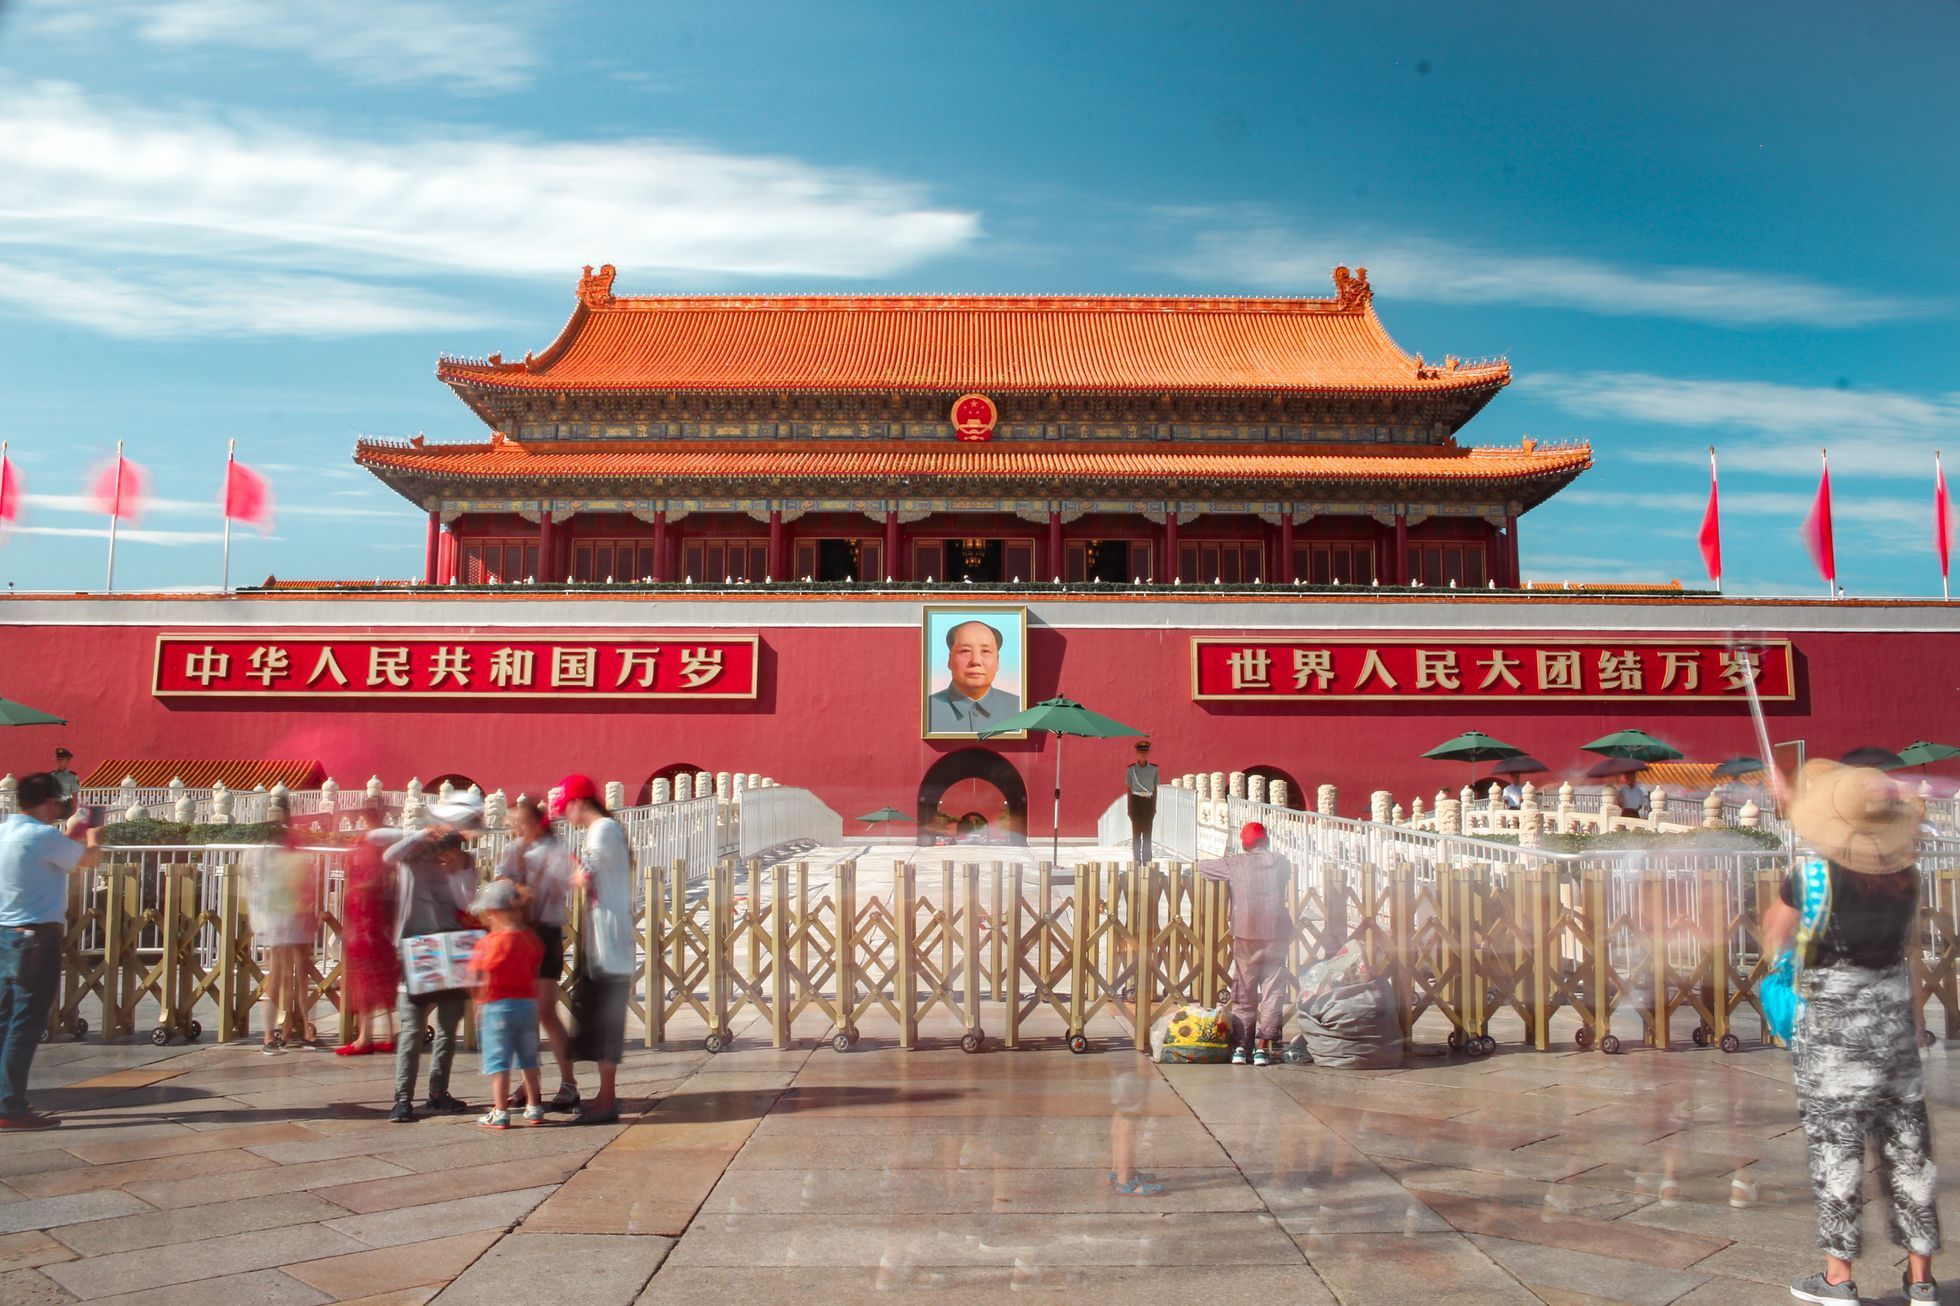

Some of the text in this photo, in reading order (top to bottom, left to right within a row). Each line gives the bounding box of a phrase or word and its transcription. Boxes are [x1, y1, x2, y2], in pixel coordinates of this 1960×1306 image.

[184, 646, 723, 688] 中华人民共和国万岁
[1226, 649, 1762, 690] 世界人民大团结万岁
